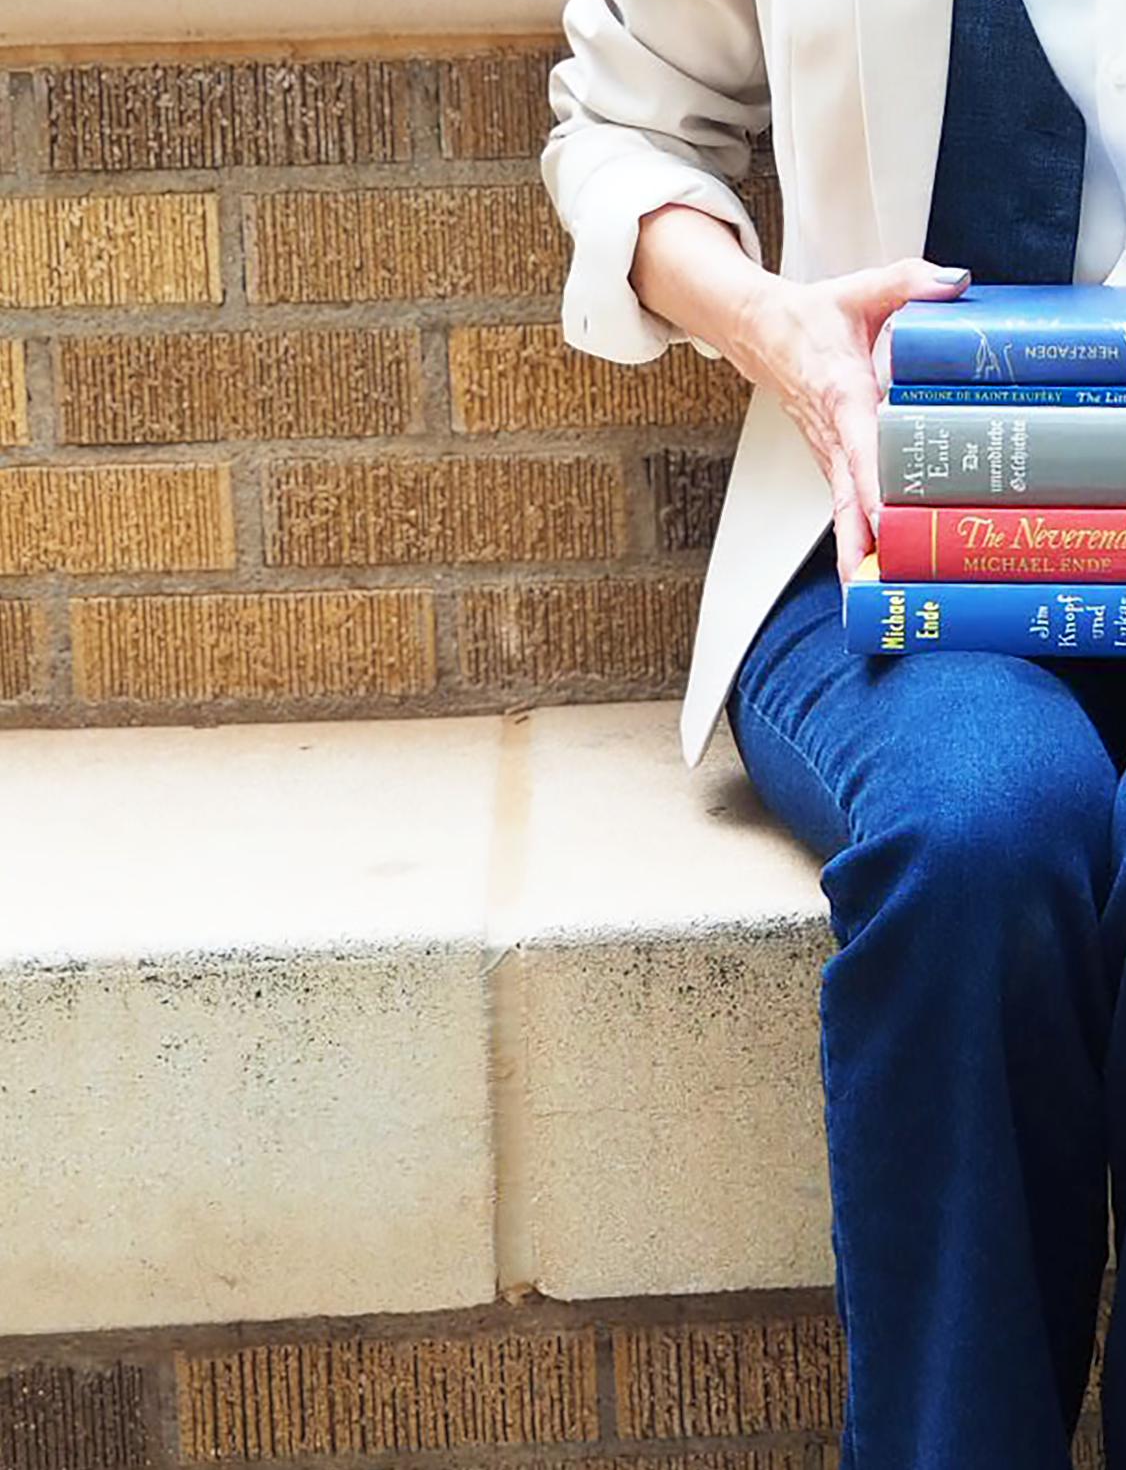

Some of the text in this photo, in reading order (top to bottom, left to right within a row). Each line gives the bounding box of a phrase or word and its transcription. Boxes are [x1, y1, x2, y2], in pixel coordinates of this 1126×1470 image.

[1024, 345, 1119, 360] HERZFADEN
[900, 390, 954, 401] ANTOINE
[956, 390, 971, 401] DE
[1075, 391, 1101, 403] The
[902, 414, 925, 497] Michael
[927, 428, 949, 478] Ende
[962, 442, 979, 472] Die
[987, 419, 1004, 492] unendliche
[957, 517, 1006, 548] The
[963, 557, 1113, 573] MICHAEL ENDE
[881, 589, 905, 649] Michael
[915, 601, 939, 639] Ende
[1029, 605, 1049, 639] Jim
[1057, 593, 1084, 647] Knopf
[1086, 605, 1106, 639] und
